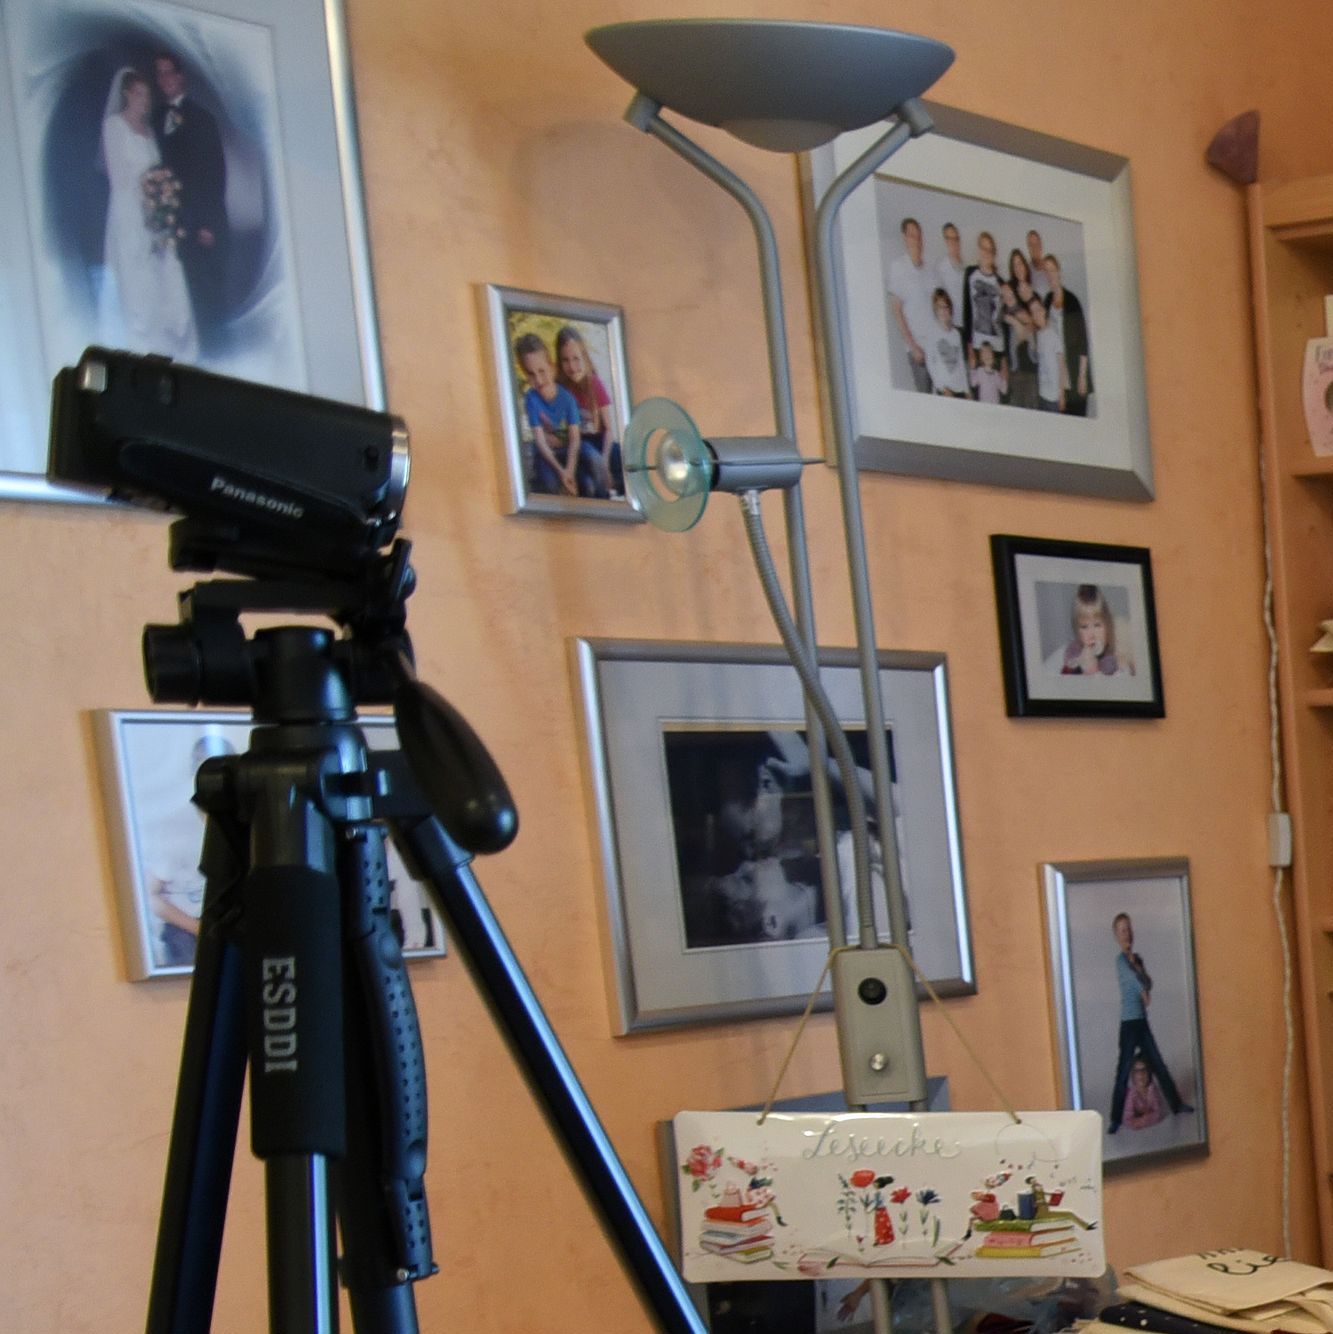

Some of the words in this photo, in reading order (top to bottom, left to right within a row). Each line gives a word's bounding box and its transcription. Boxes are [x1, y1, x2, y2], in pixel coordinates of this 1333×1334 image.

[210, 475, 305, 518] Panasonic
[262, 957, 297, 1073] ESDDI
[802, 1121, 962, 1161] Leseecke
